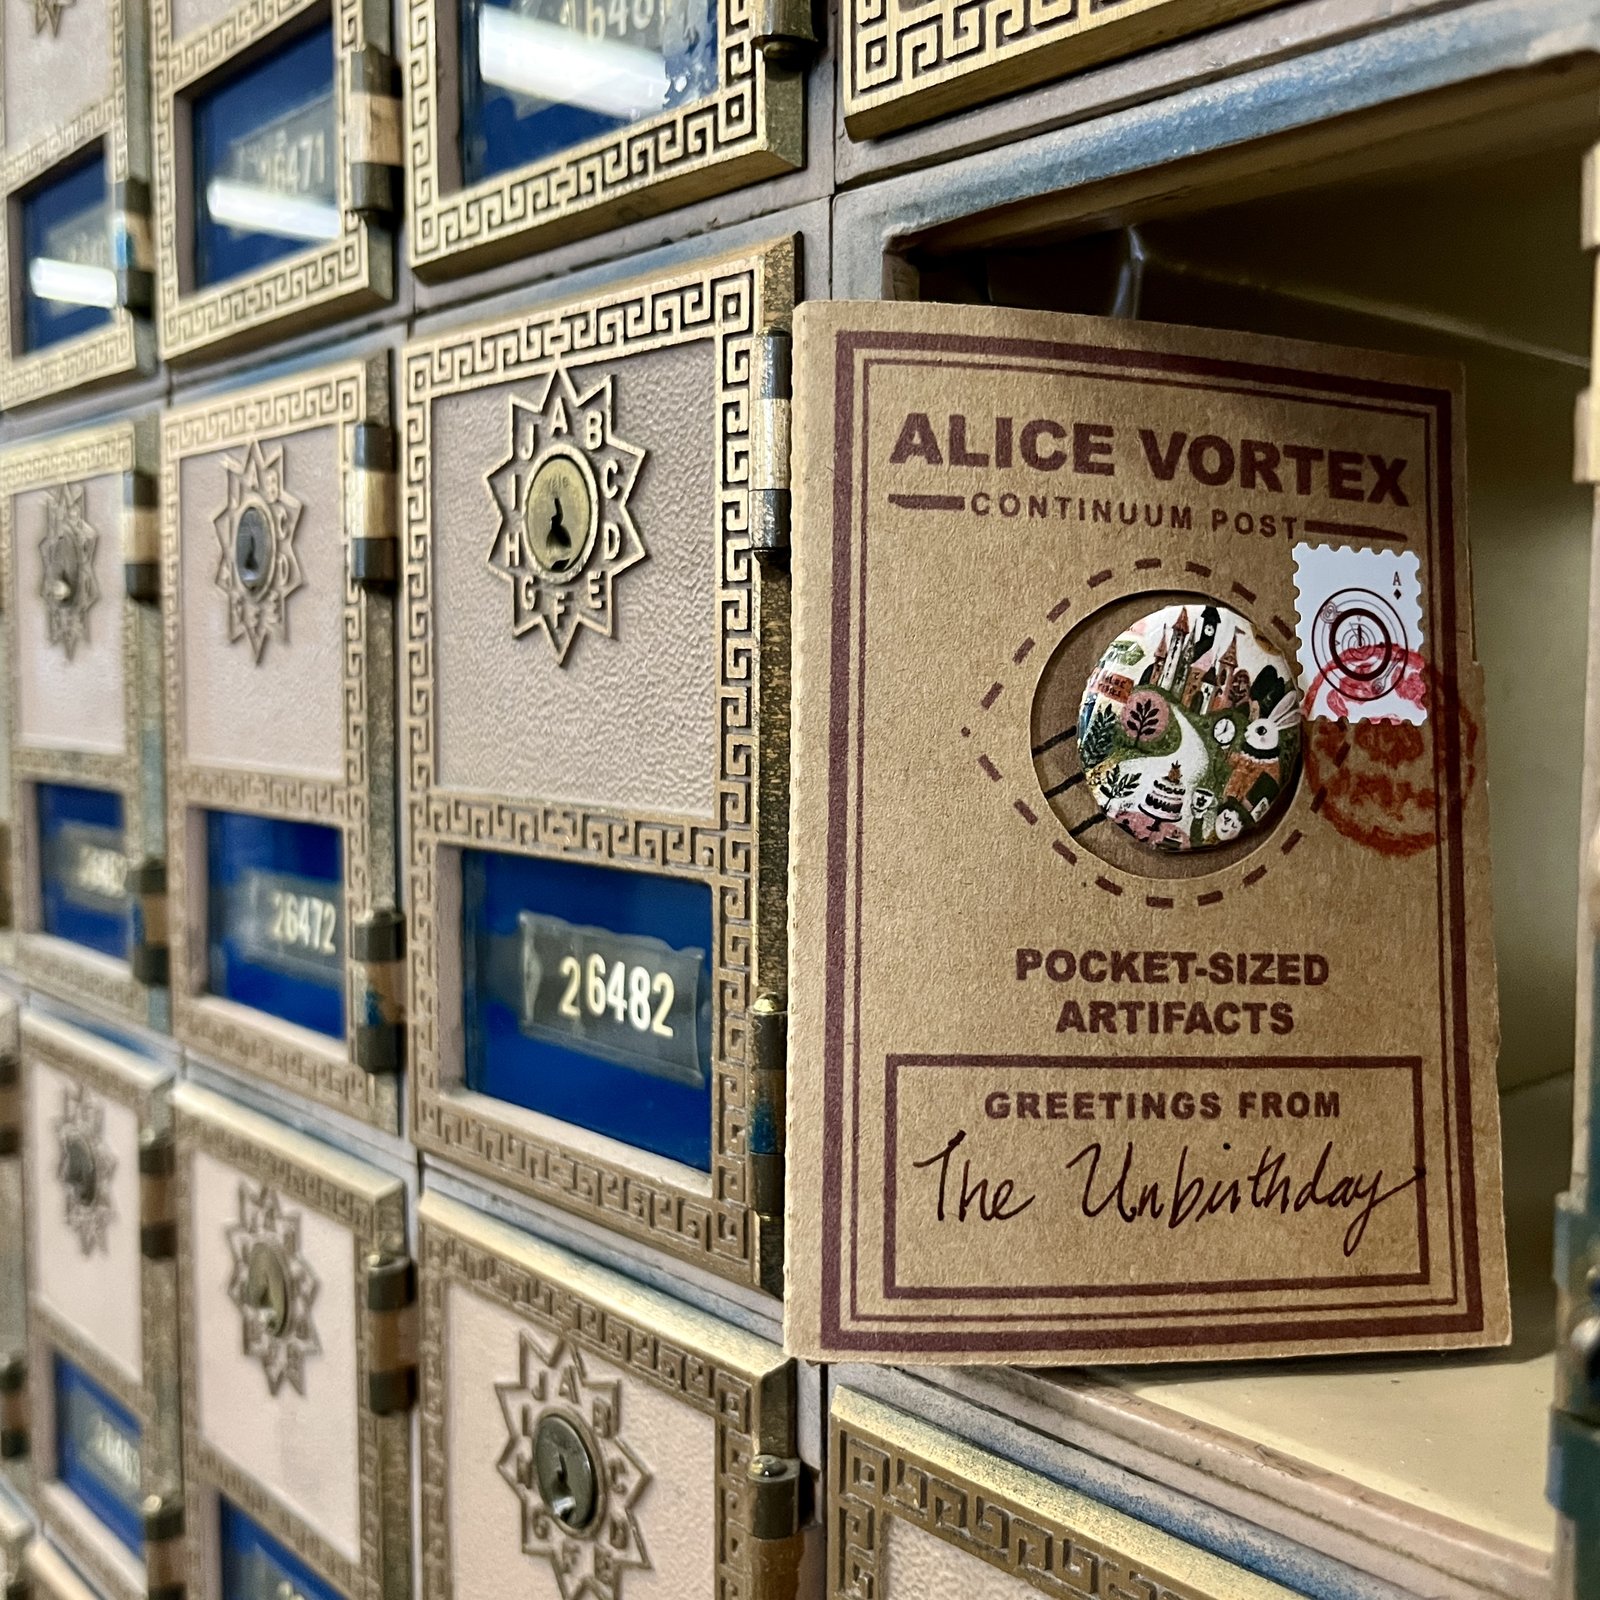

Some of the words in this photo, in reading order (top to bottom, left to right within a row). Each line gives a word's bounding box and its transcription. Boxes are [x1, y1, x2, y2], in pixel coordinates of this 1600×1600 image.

[551, 396, 568, 435] A
[585, 410, 603, 450] B
[520, 423, 536, 461] J
[889, 412, 1116, 476] ALICE
[1138, 428, 1410, 507] VORTEX
[511, 473, 518, 511] I
[602, 459, 619, 499] C
[970, 491, 1193, 532] CONTINUUM
[1211, 508, 1300, 542] POST
[505, 532, 521, 567] H
[603, 523, 620, 560] D
[521, 575, 537, 610] G
[587, 571, 604, 610] E
[1392, 570, 1402, 587] A
[553, 591, 571, 629] F
[271, 889, 337, 954] 26472
[1015, 949, 1329, 986] POCKET-SIZED
[557, 952, 675, 1038] 26482
[1055, 1000, 1294, 1036] ARTIFACTS
[984, 1091, 1222, 1120] GREETINGS
[1238, 1091, 1341, 1119] FROM
[913, 1130, 1036, 1223] The
[1066, 1141, 1425, 1257] Unbirthday
